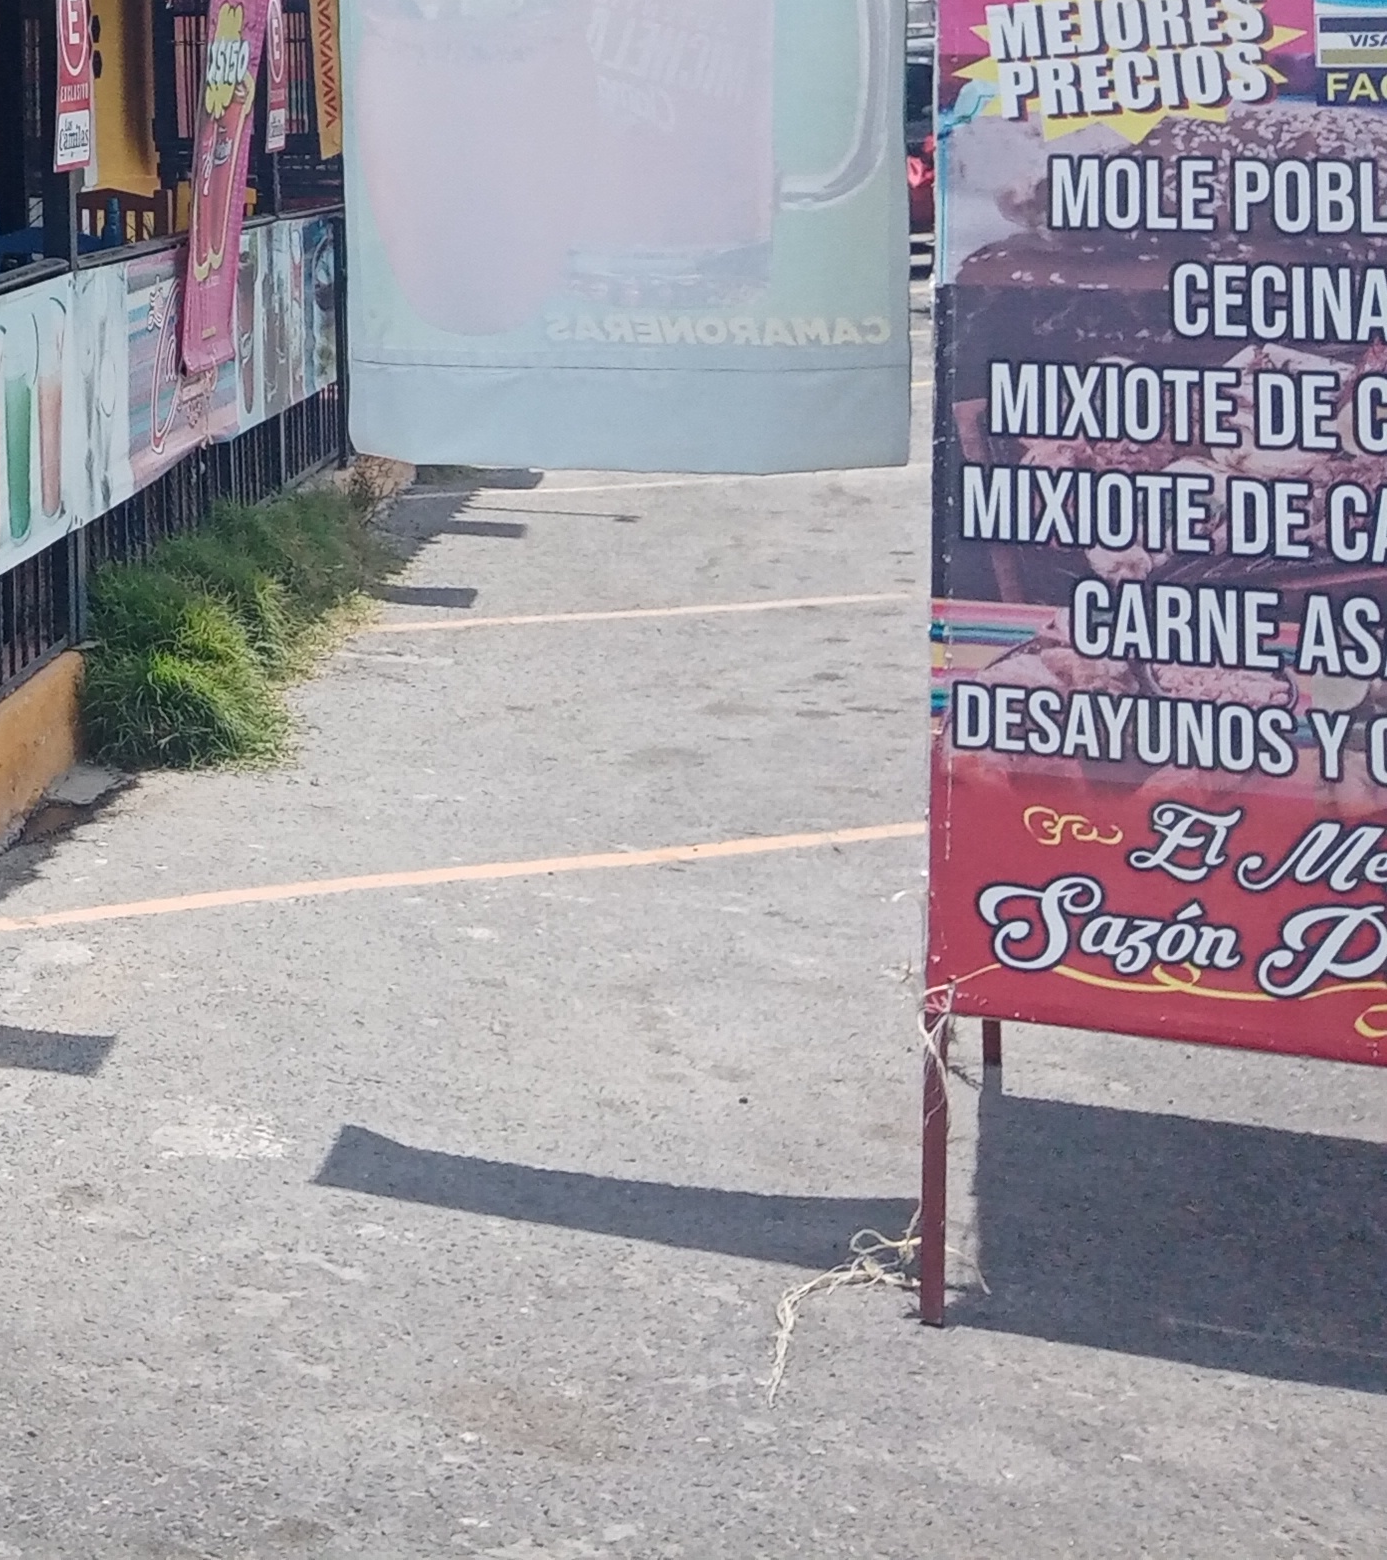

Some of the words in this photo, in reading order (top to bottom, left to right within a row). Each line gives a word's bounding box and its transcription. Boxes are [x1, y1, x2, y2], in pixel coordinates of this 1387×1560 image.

[997, 43, 1273, 120] PRECIOS
[1050, 158, 1215, 230] MOLE
[1173, 263, 1387, 340] CECINA
[989, 362, 1238, 446] MIXIOTE
[1258, 373, 1338, 449] DE
[963, 466, 1211, 552] MIXIOTE
[1232, 479, 1310, 558] DE
[1073, 581, 1280, 668] CARNE
[1299, 596, 1387, 674] AS
[954, 684, 1293, 776] DESAYUNOS
[1314, 714, 1351, 779] Y
[1129, 802, 1243, 882] El
[978, 876, 1242, 974] Sazón
